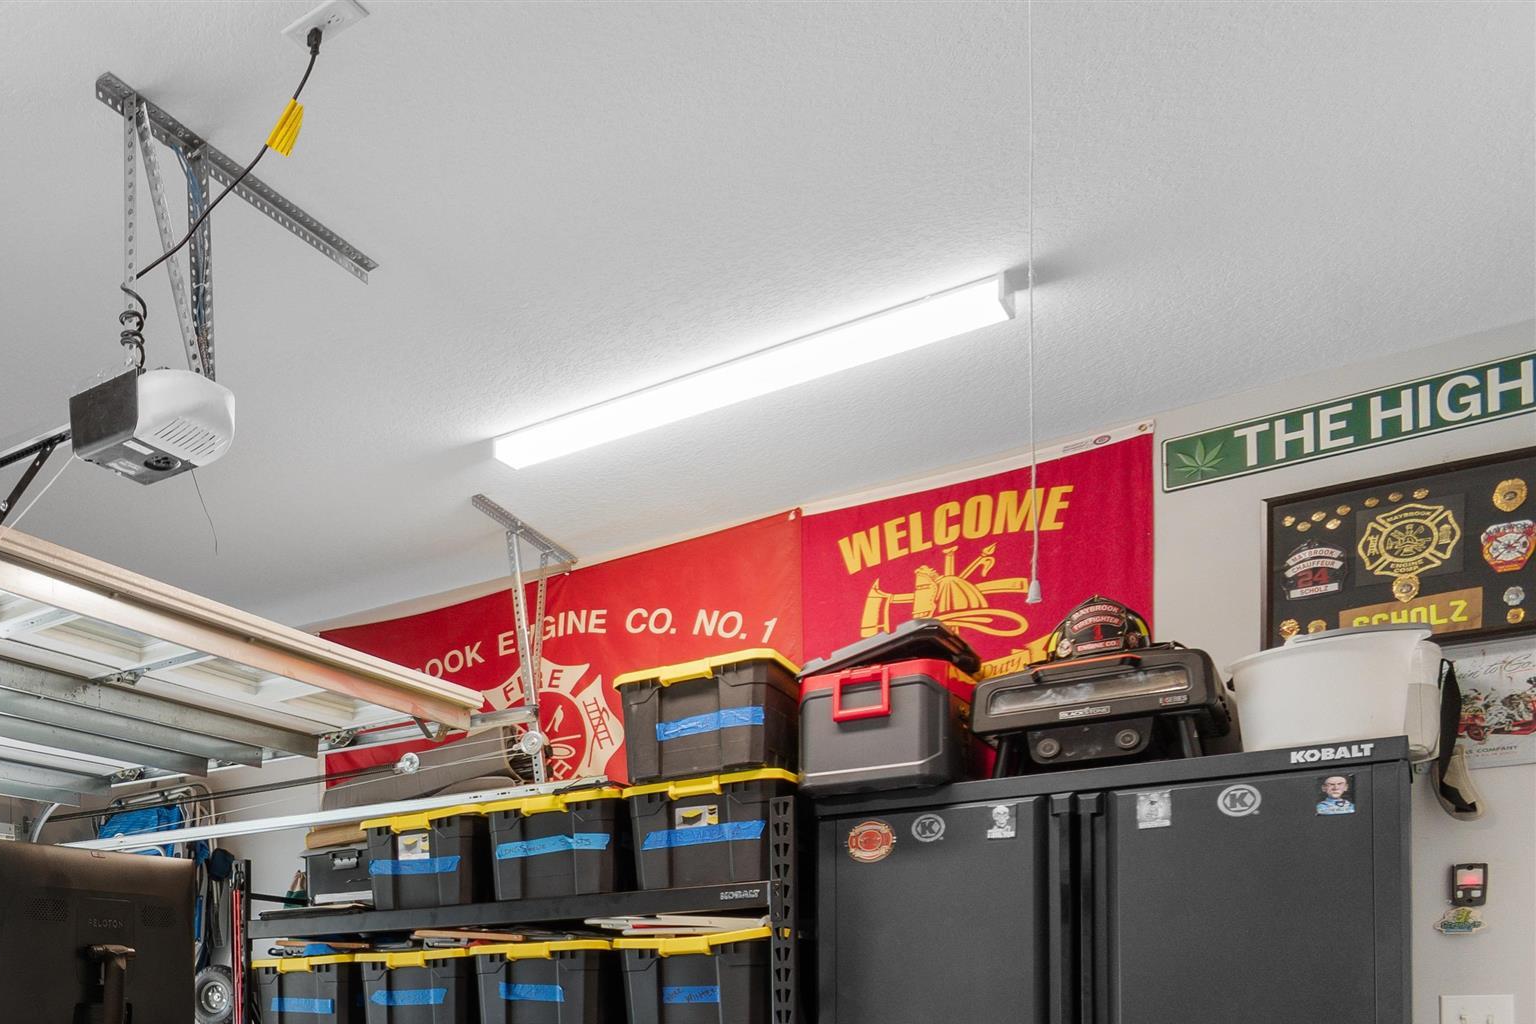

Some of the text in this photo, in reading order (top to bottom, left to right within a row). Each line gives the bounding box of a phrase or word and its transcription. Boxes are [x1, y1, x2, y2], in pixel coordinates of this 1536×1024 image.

[1233, 359, 1535, 467] THE HIGH
[838, 485, 1074, 576] WELCOME
[1291, 549, 1336, 562] MAYBROOK
[1390, 559, 1424, 569] ENGINE
[1291, 560, 1336, 574] CHAUFFEUR
[1296, 567, 1329, 588] 24
[1300, 585, 1329, 596] SCHOLZ
[1093, 624, 1104, 641] 1
[415, 607, 778, 679] OOK EGINE CO. NO. 1
[501, 669, 564, 702] FIE
[1290, 743, 1375, 764] KOBALT
[719, 889, 761, 901] KOBALT
[88, 918, 128, 929] PELOTON
